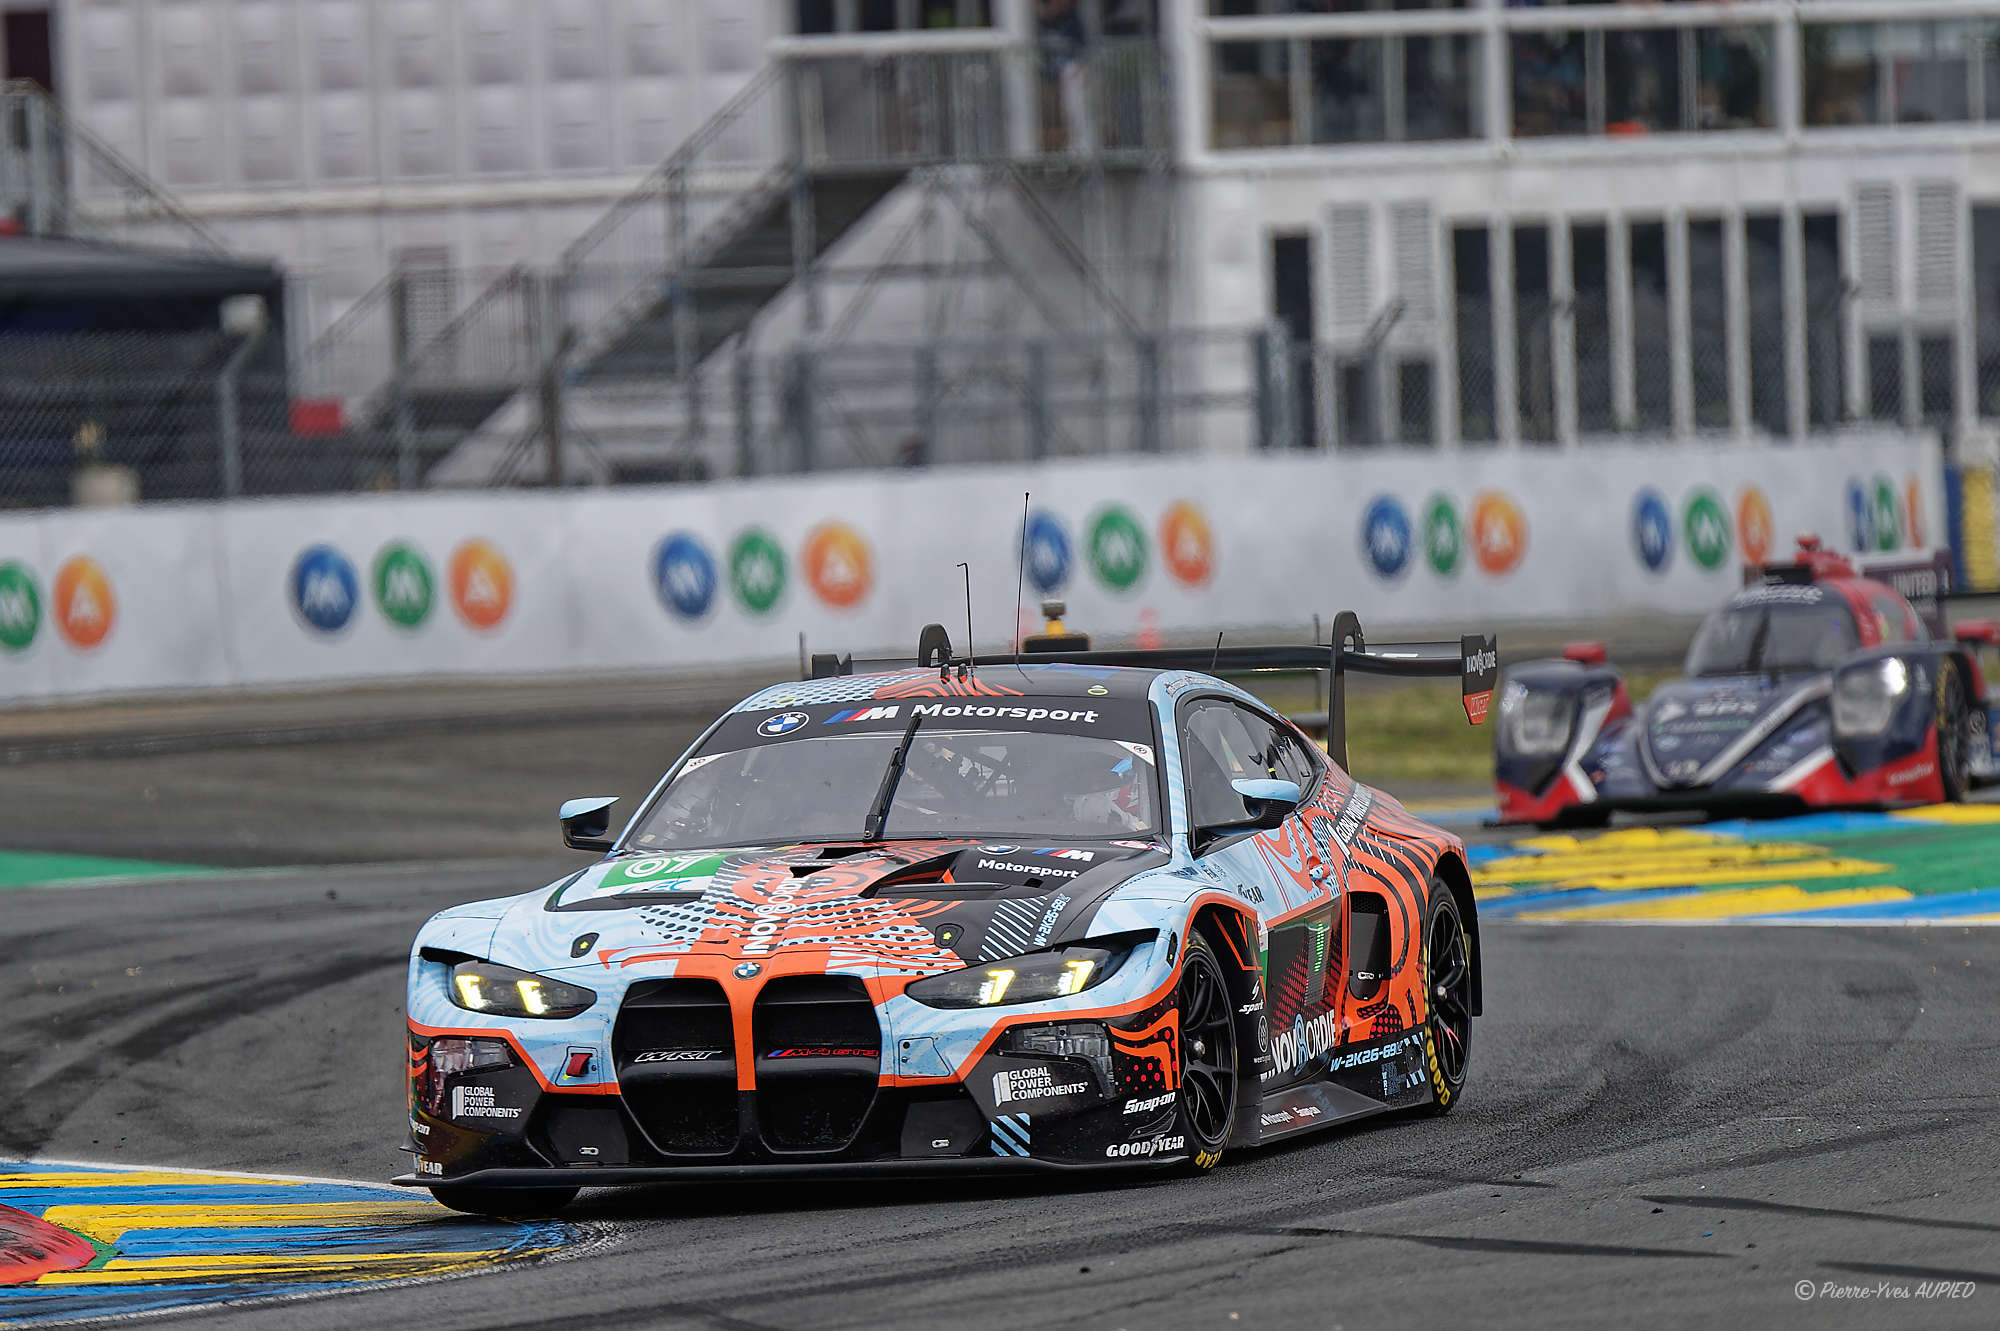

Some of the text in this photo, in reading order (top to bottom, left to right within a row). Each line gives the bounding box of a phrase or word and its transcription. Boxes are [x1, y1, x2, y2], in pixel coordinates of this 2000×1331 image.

[911, 703, 1099, 723] Motorsport
[977, 858, 1080, 879] Motorsport
[634, 1050, 723, 1063] WRT
[1008, 1066, 1051, 1080] GLOBAL
[464, 1086, 496, 1097] GLOBAL
[1010, 1078, 1052, 1091] POWER
[464, 1097, 495, 1107] POWER
[1122, 1092, 1175, 1114] Snap-on
[1106, 1134, 1185, 1158] GOODYEAR
